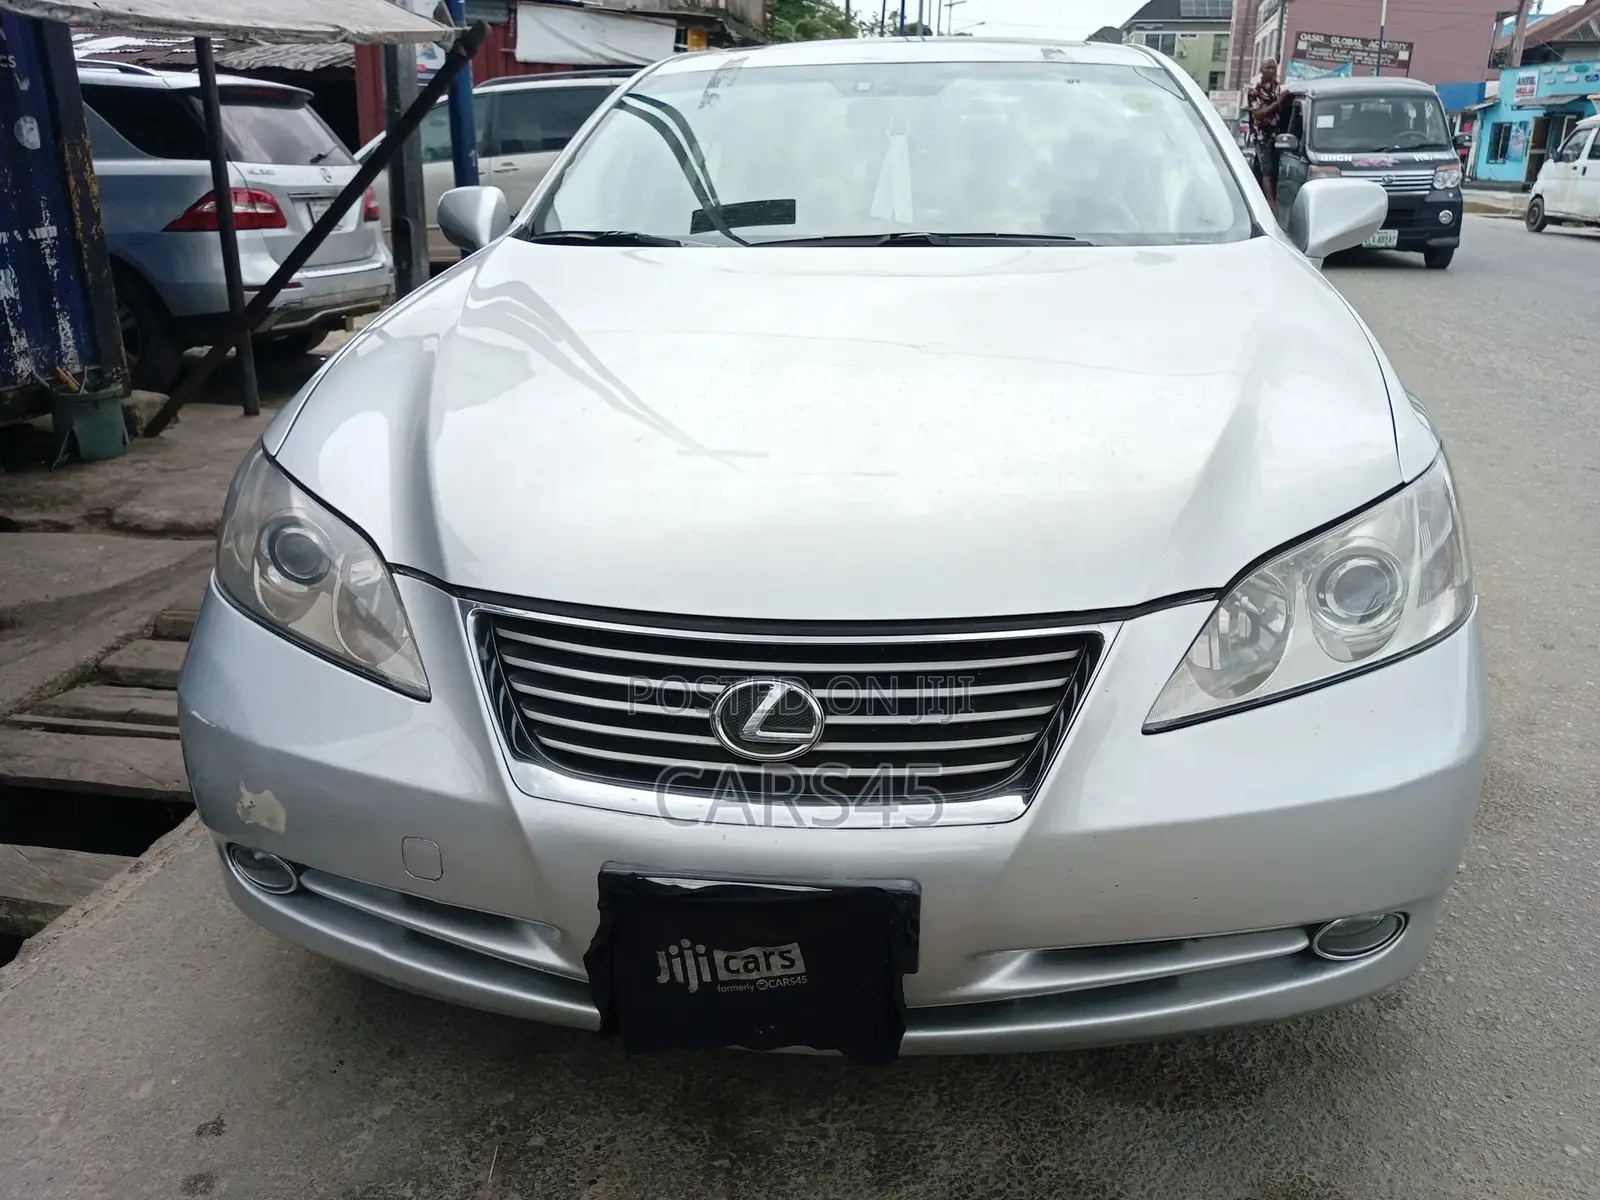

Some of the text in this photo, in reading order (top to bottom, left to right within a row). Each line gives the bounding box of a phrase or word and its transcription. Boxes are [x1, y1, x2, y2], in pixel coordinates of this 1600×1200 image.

[1330, 36, 1362, 47] GLOBAL
[717, 975, 808, 993] formerly CARS45
